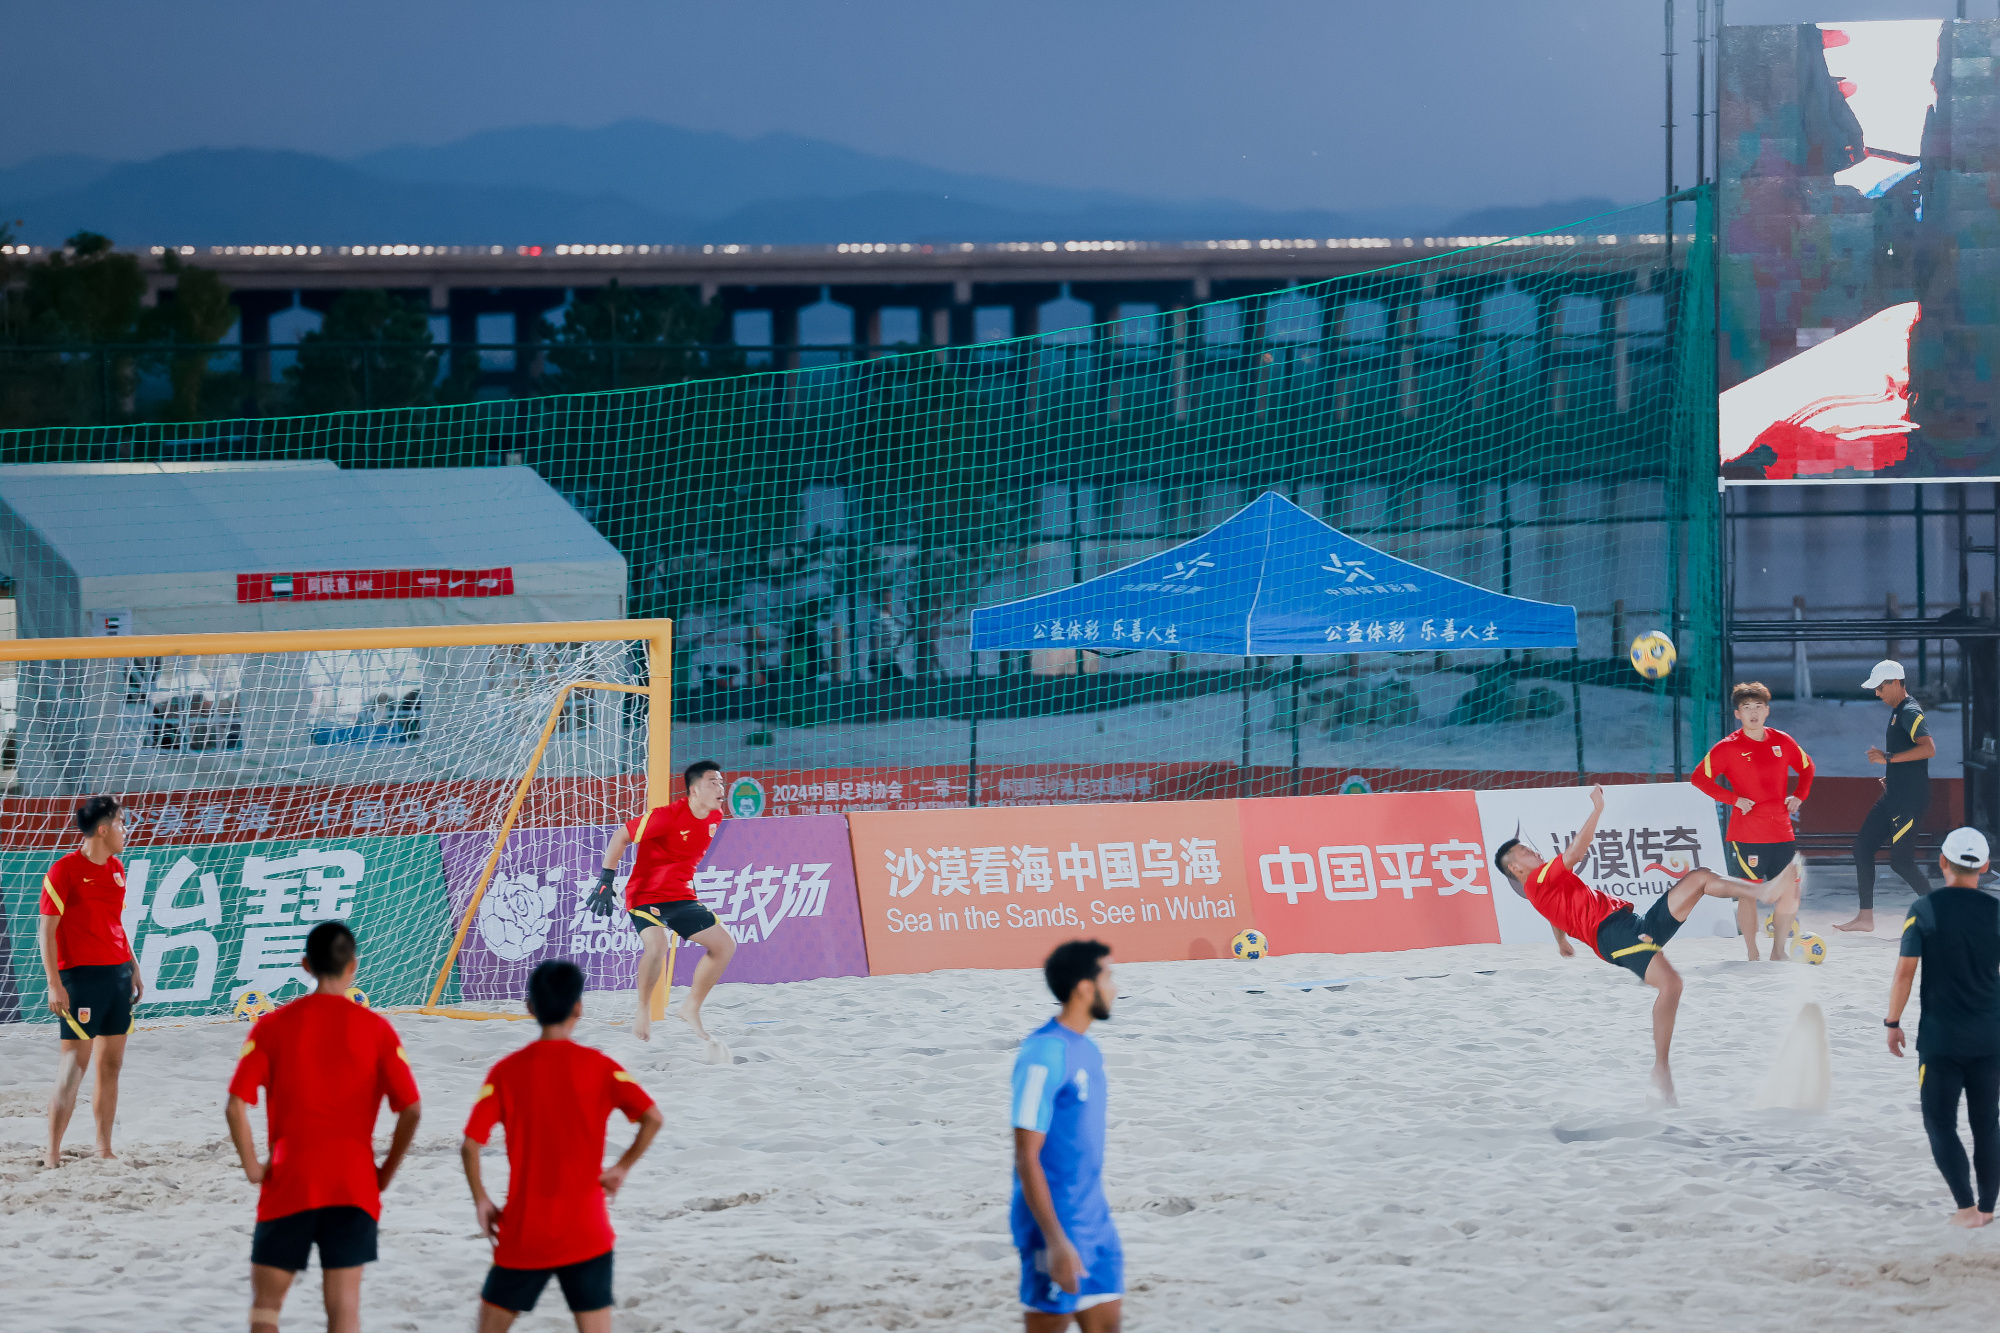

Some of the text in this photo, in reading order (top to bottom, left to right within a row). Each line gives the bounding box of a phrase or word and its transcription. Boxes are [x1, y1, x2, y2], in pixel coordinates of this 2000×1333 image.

[1033, 618, 1180, 643] 公益体彩 乐善人生
[1324, 618, 1500, 643] 公益体彩 乐善人生
[1258, 839, 1490, 904] 中国平安
[886, 894, 1236, 933] Sea in the Sands, See in Wuhai
